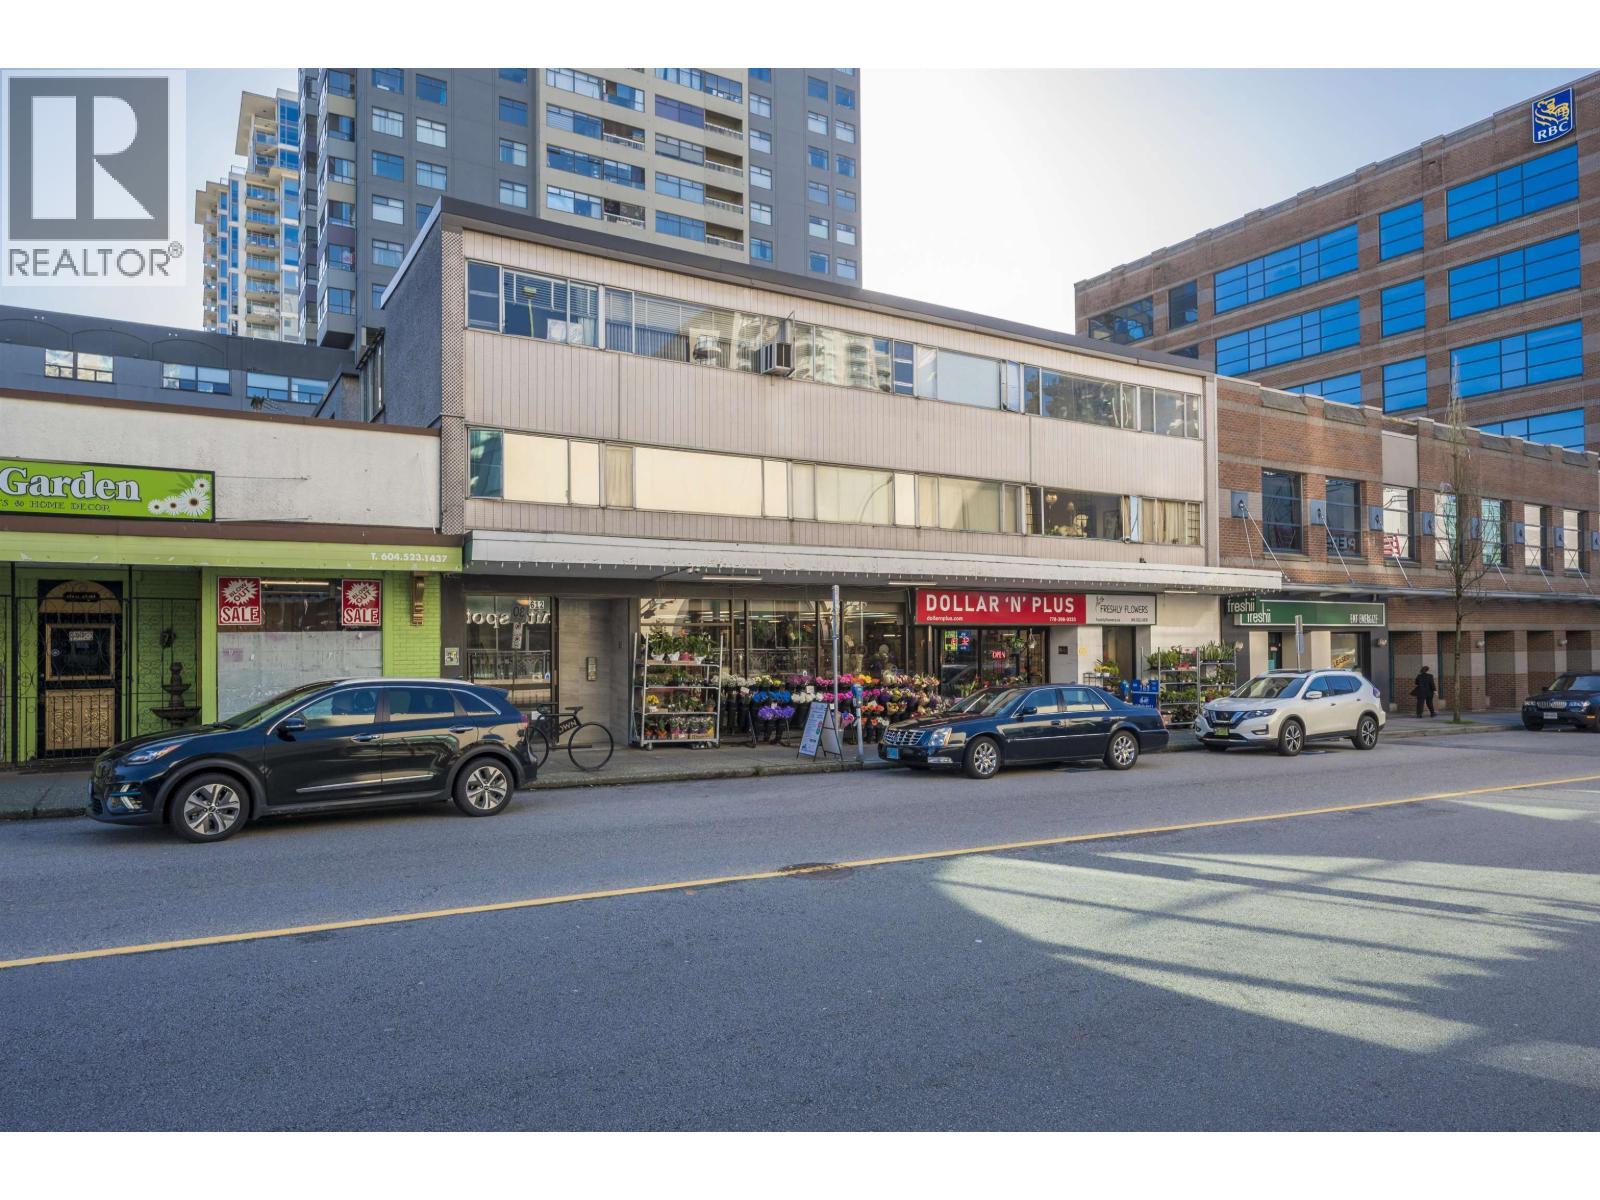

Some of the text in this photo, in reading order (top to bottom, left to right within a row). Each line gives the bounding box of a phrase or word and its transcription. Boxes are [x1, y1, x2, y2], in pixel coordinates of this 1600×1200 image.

[1537, 121, 1568, 140] RBC
[0, 466, 142, 501] Garden
[31, 500, 65, 510] HOME
[70, 502, 110, 513] DECOR
[381, 552, 448, 563] 604.523.1437
[229, 582, 249, 598] BLOW
[233, 587, 251, 602] OUT
[351, 585, 370, 599] BLOW
[356, 589, 372, 604] OUT
[530, 601, 544, 609] 612
[926, 594, 999, 612] DOLLAR
[1032, 597, 1075, 613] PLUS
[1100, 604, 1149, 614] FRESHLY FLOWERS
[1227, 598, 1255, 613] freshii
[222, 607, 259, 622] SALE
[344, 608, 379, 623] SALE
[1247, 602, 1272, 623] freshii
[992, 650, 1006, 659] OPEN
